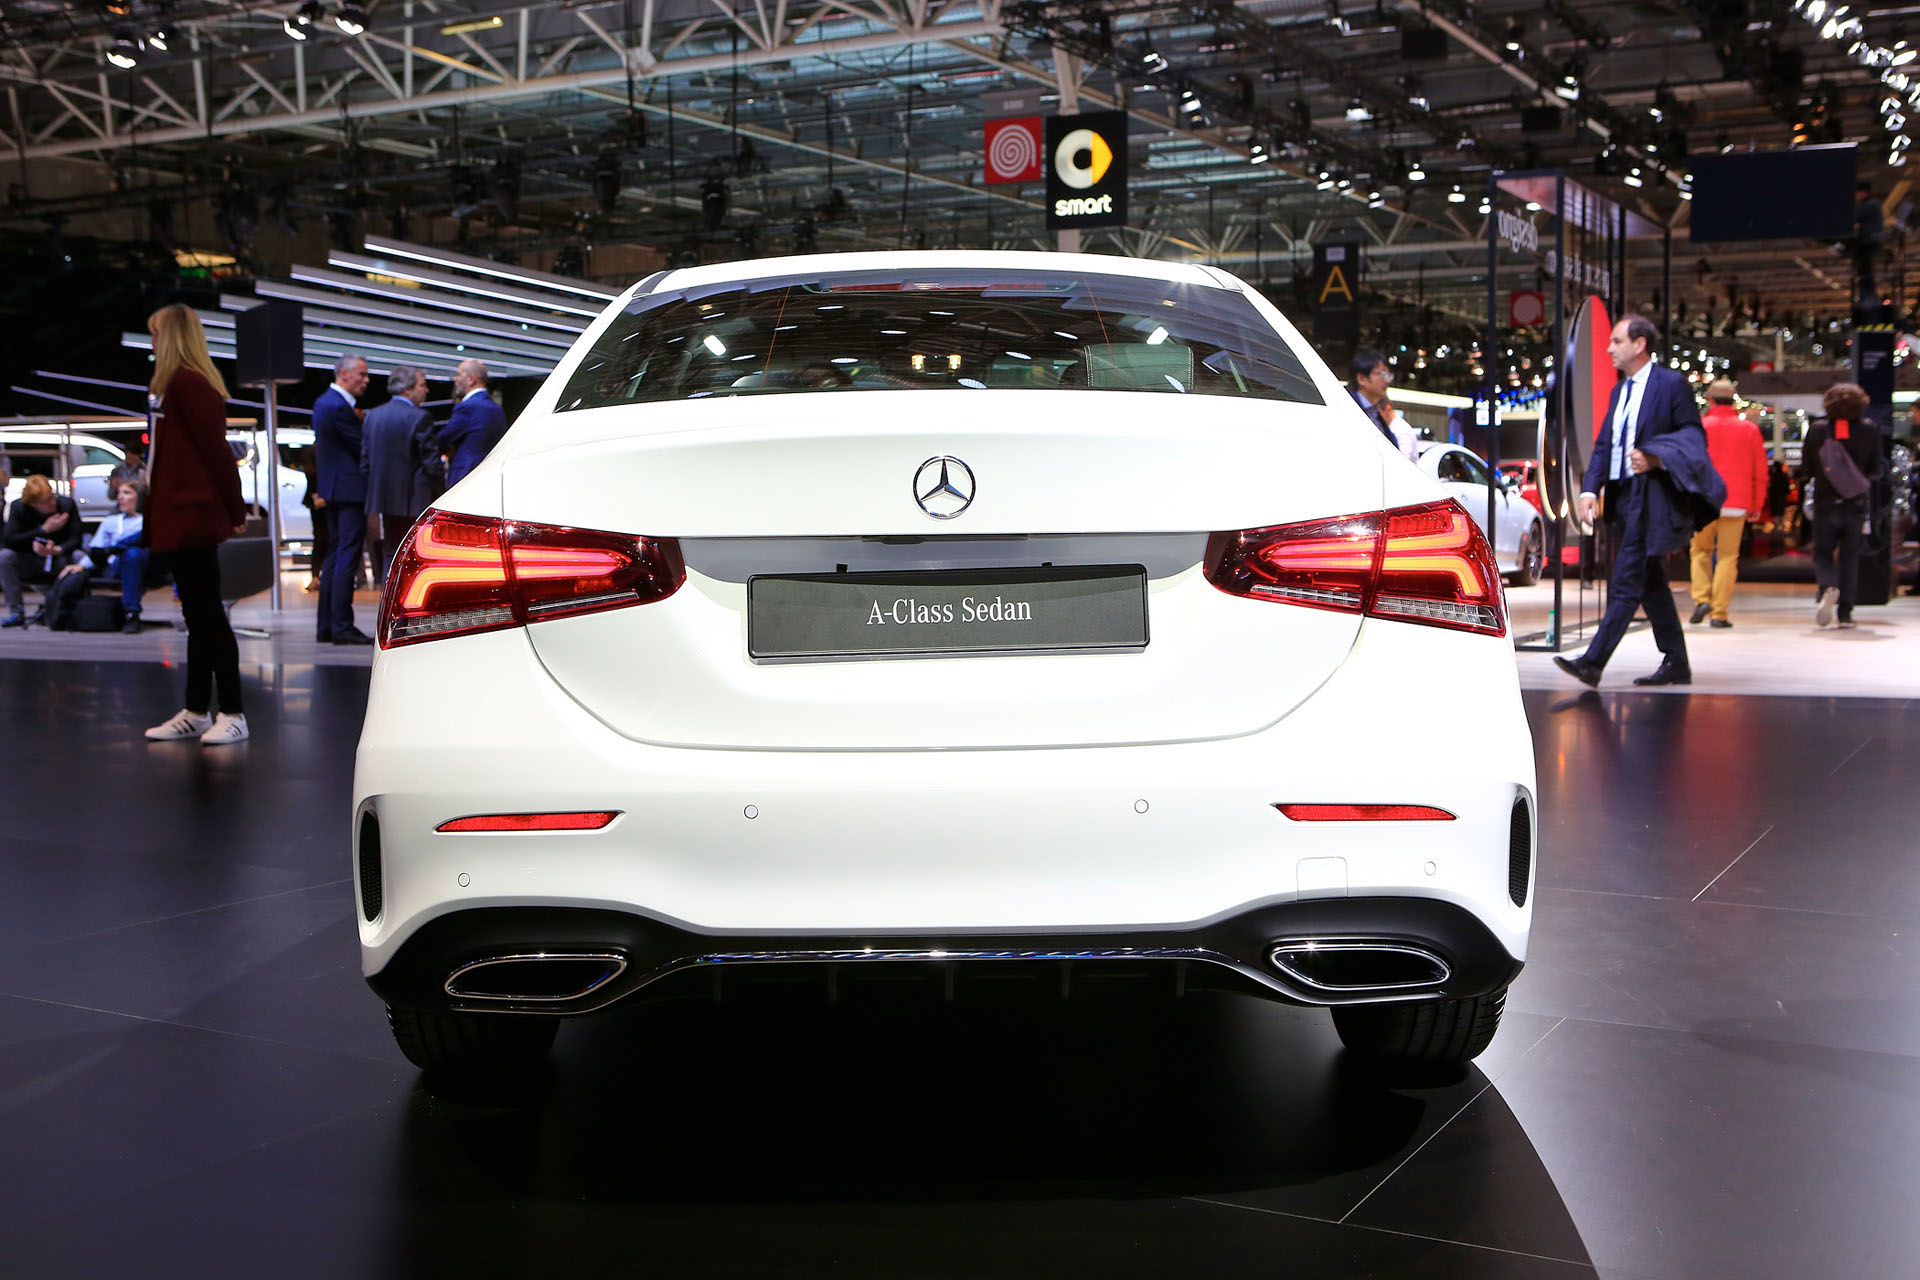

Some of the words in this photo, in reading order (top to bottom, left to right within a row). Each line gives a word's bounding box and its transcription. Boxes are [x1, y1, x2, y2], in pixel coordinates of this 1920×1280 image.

[1055, 194, 1112, 216] smart
[1319, 265, 1353, 303] A
[866, 598, 954, 625] A-Class
[962, 595, 1033, 622] Sedan
